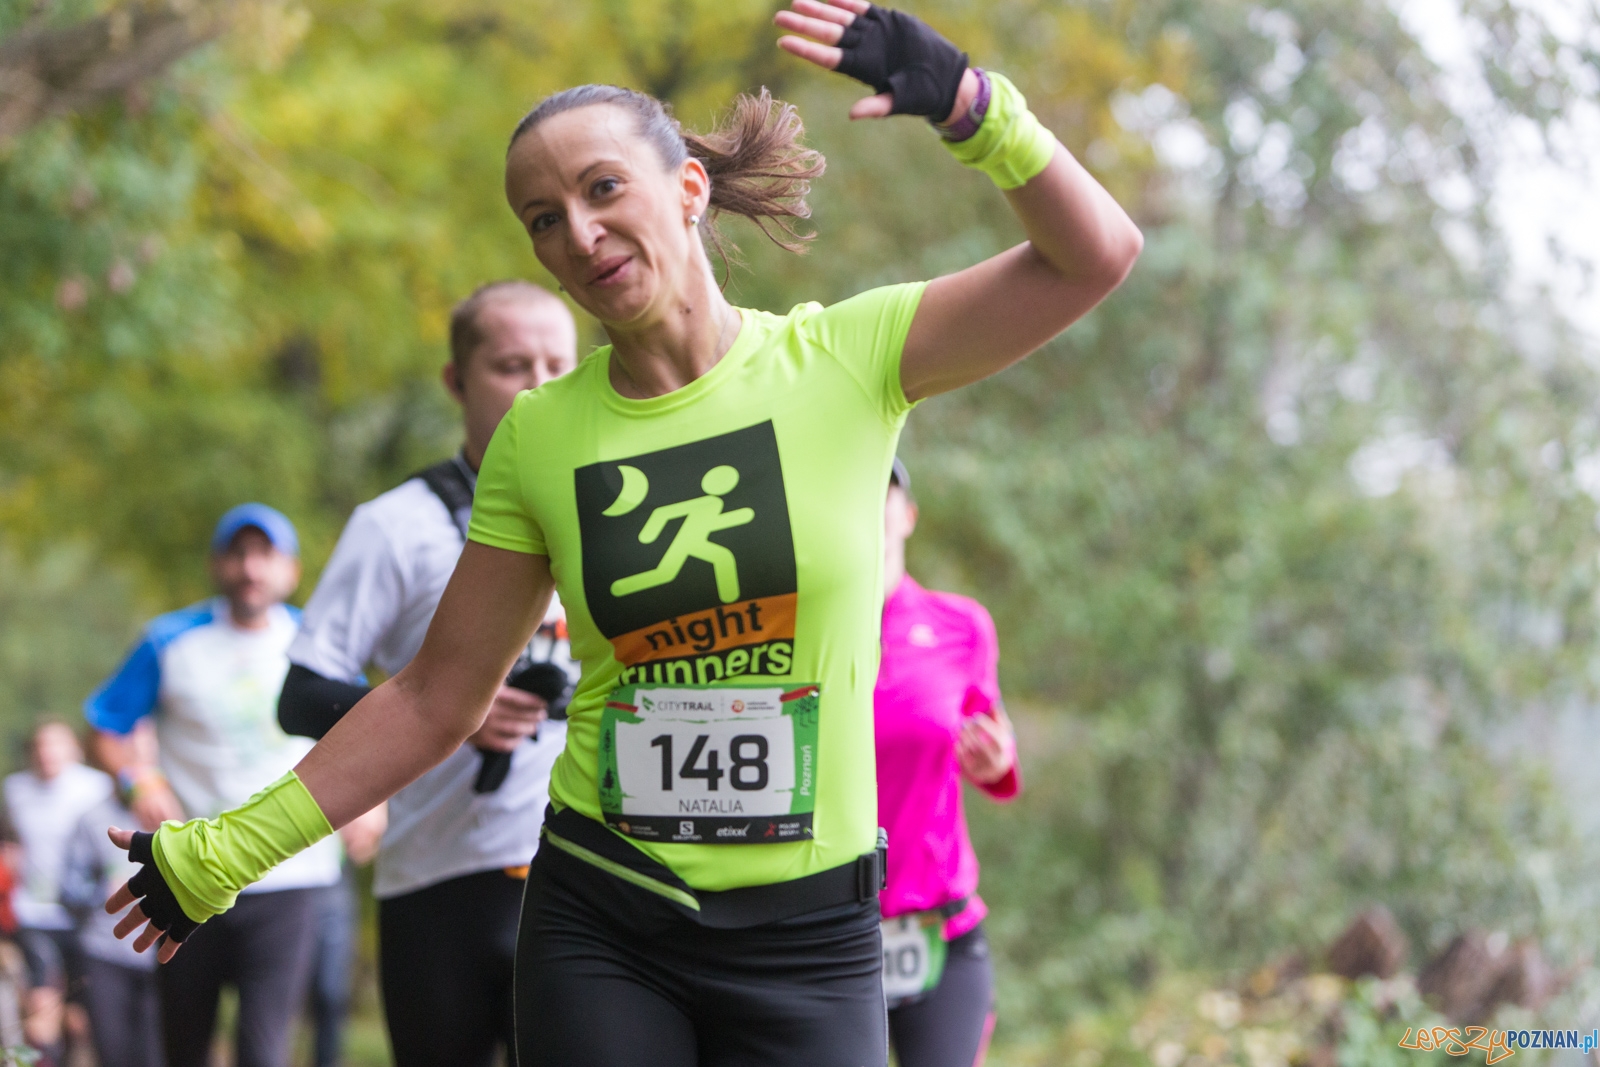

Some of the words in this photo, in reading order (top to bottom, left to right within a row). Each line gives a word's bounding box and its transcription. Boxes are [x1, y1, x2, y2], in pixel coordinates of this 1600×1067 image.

[645, 602, 763, 652] night
[623, 641, 792, 685] runners
[650, 734, 769, 792] 148
[678, 798, 745, 814] NATALIA
